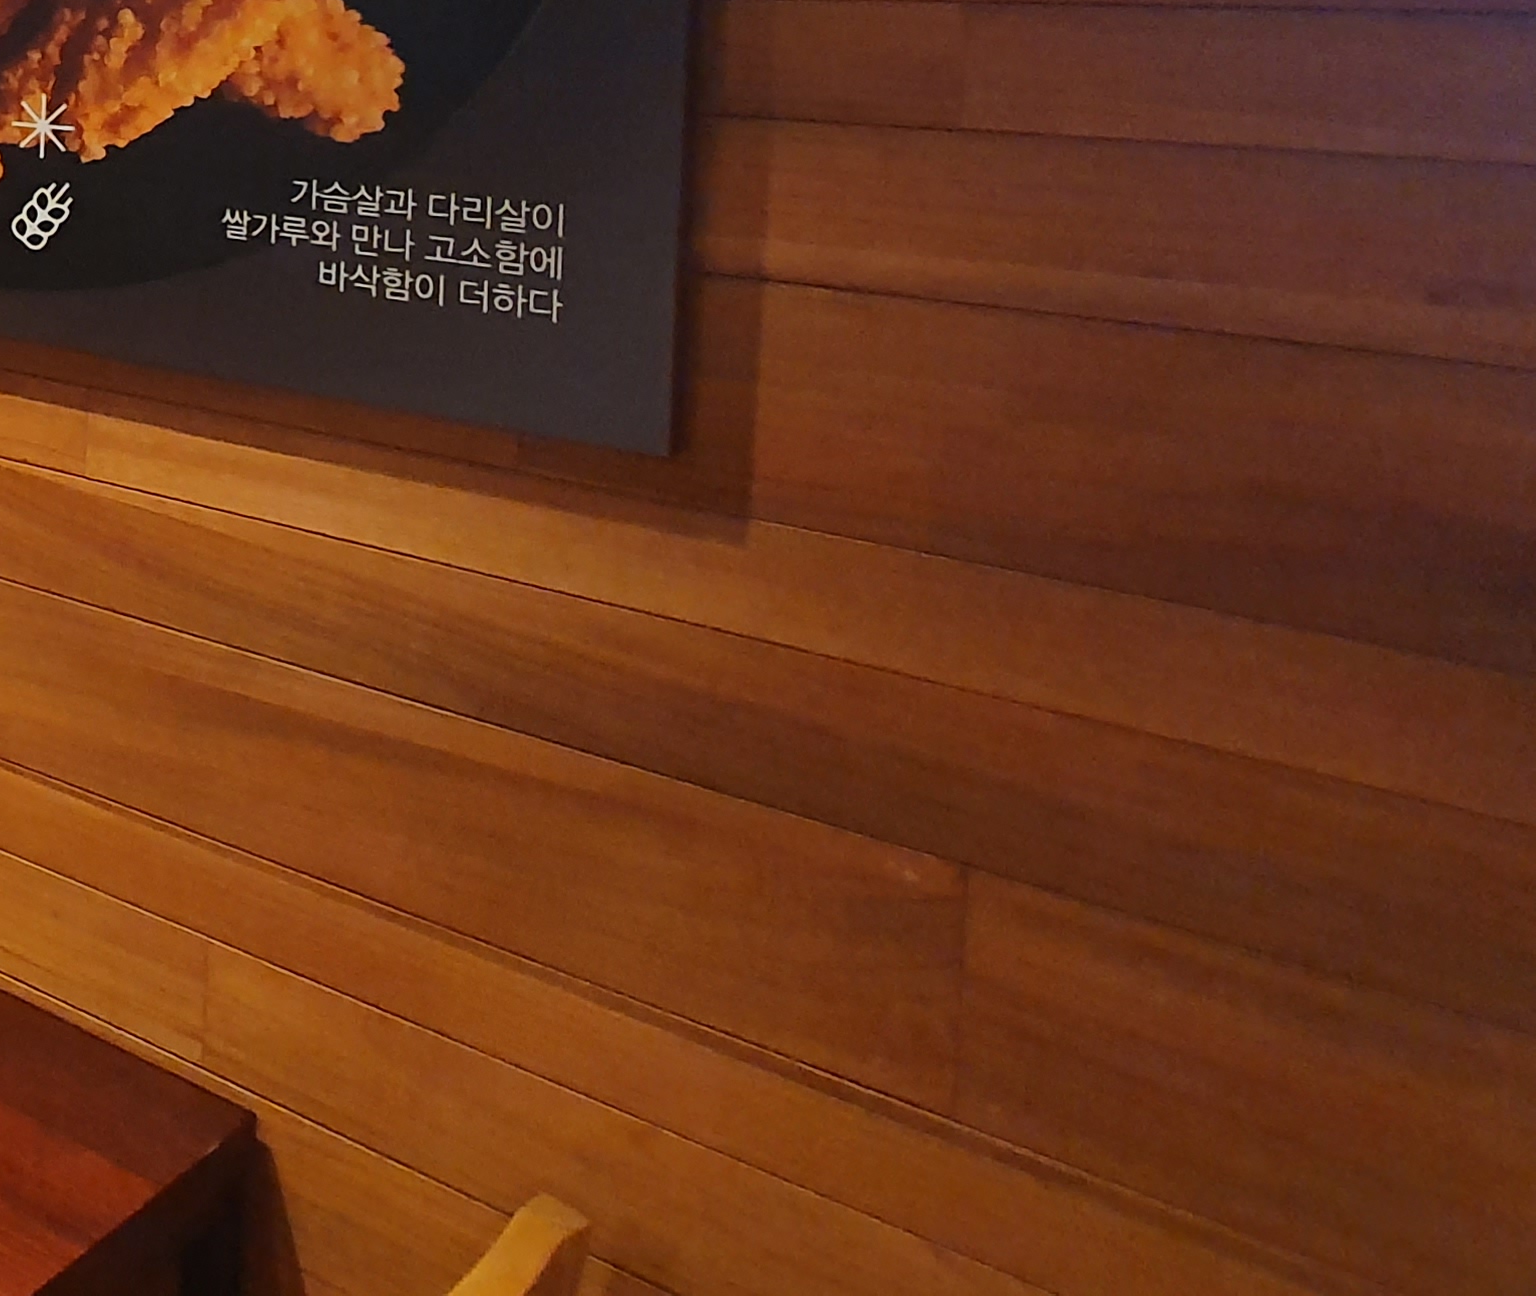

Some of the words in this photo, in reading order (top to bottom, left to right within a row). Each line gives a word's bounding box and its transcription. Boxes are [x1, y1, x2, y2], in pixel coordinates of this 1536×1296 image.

[291, 179, 417, 219] 가슴살과
[427, 192, 566, 238] 다리살이
[221, 207, 341, 252] 쌀가루와
[351, 227, 415, 261] 만나
[424, 232, 564, 281] 고소함에
[318, 260, 446, 306] 바삭함이
[458, 276, 564, 324] 더하다
